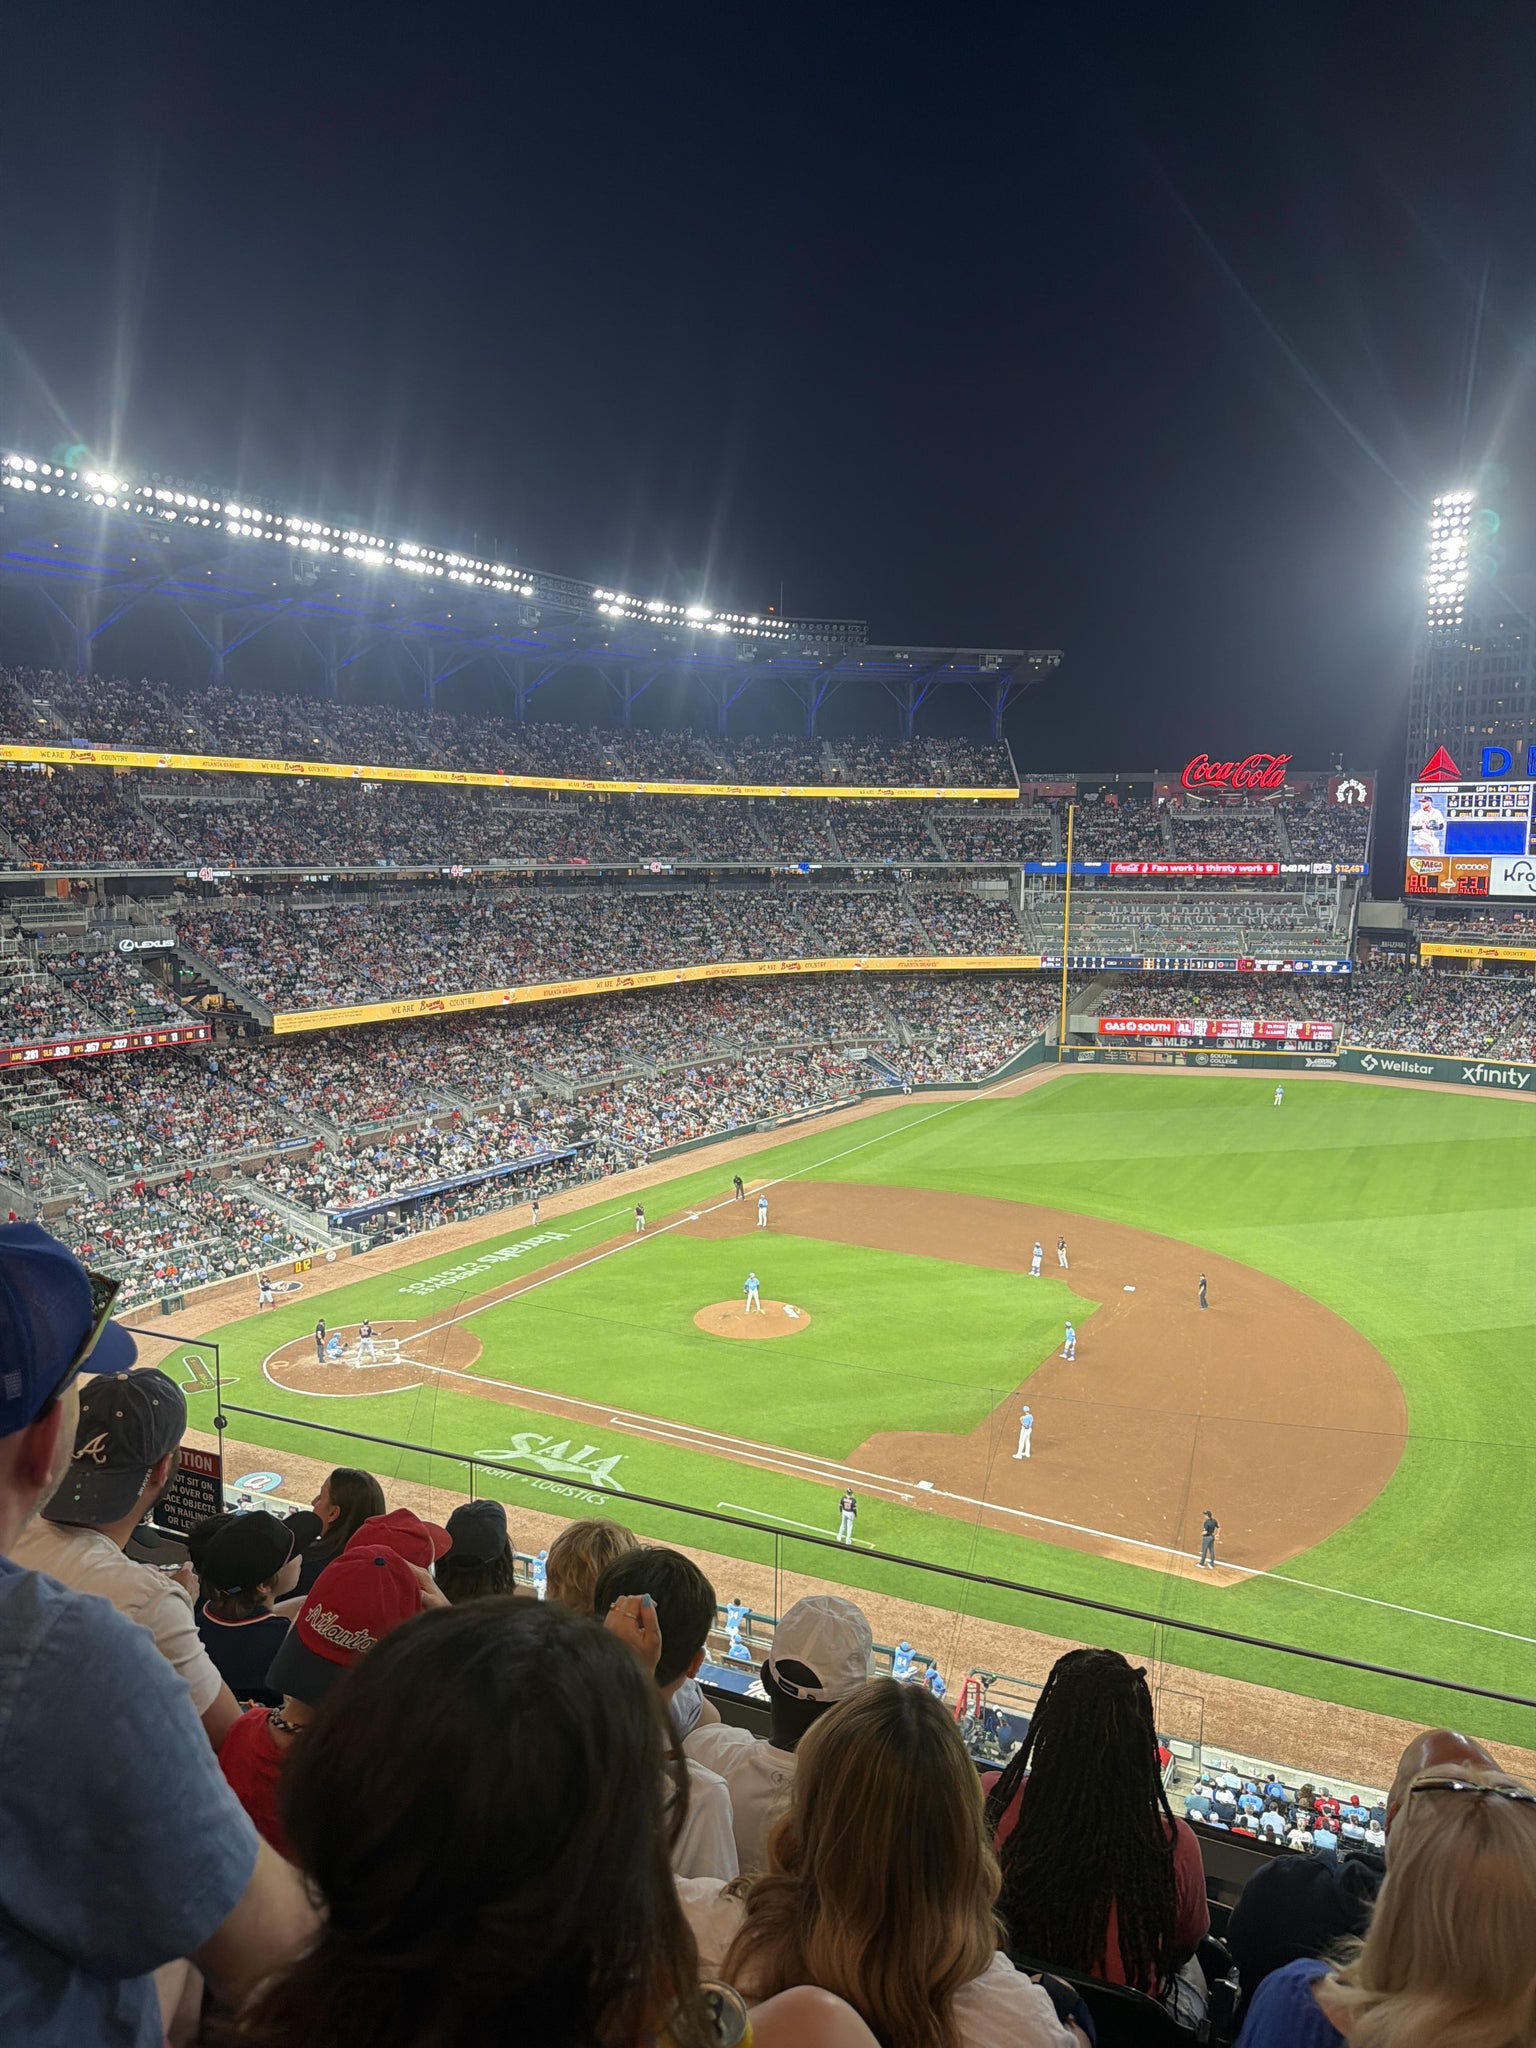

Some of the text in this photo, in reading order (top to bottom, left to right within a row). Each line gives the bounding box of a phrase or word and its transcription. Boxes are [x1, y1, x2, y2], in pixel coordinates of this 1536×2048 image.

[40, 750, 128, 763] WE ARE Braves COUNTRY
[1181, 753, 1293, 790] Coca-Cola
[1151, 864, 1263, 873] Fan work is thirsty work
[1110, 905, 1304, 925] HANK AARON TERRACE
[134, 940, 175, 949] LEXUS
[391, 997, 475, 1015] WE ARE Braves COUNTRY
[1104, 1021, 1171, 1032] GAS SOUTH
[1177, 1023, 1192, 1033] AL
[1164, 1037, 1194, 1047] MLB+
[1236, 1039, 1267, 1049] MLB+
[1297, 1041, 1330, 1051] MLB+
[11, 1053, 22, 1061] AVG
[1381, 1059, 1434, 1075] Wellstar
[1462, 1063, 1531, 1089] xfinity
[478, 1432, 625, 1490] SAIA
[187, 1475, 200, 1488] SIT
[201, 1480, 216, 1493] ON,
[180, 1486, 201, 1499] OVER
[202, 1491, 215, 1502] OR
[530, 1479, 610, 1506] LOGISTICS
[164, 1503, 177, 1513] ON
[182, 1498, 217, 1514] OBJECTS
[167, 1515, 179, 1525] OR
[305, 1603, 378, 1653] Atlanta
